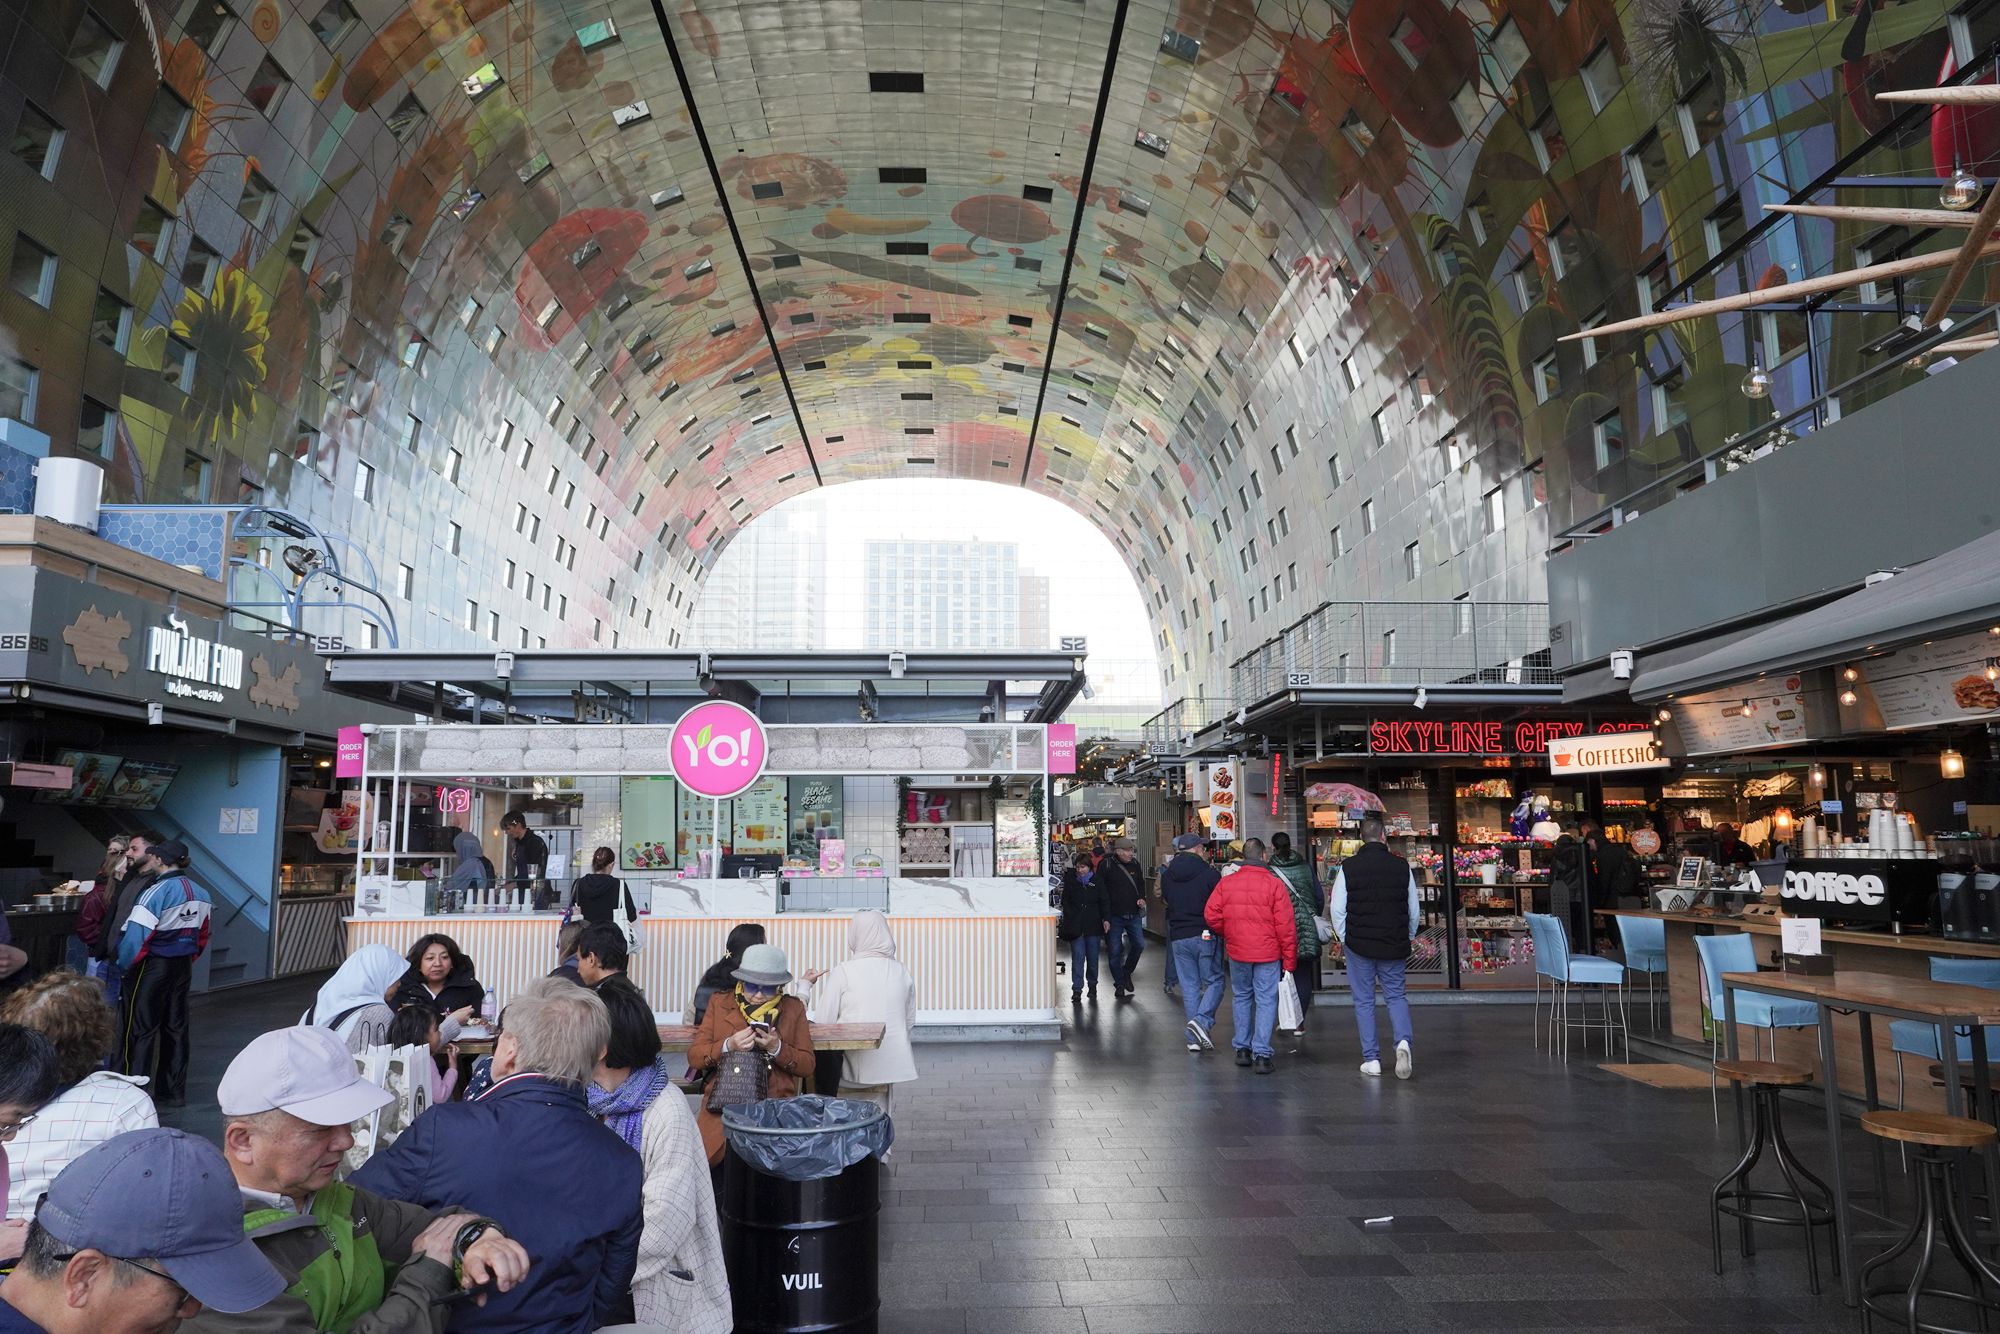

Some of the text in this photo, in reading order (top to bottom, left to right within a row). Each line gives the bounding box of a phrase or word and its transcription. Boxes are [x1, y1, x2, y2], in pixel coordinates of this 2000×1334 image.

[1, 635, 27, 650] 86
[30, 637, 48, 653] 86
[317, 637, 343, 651] 56
[1062, 637, 1086, 651] 52
[149, 614, 243, 690] PUNJABI FOOD
[1290, 674, 1310, 686] 32
[1050, 740, 1074, 748] ORDER
[1370, 722, 1503, 753] SKYLINE
[339, 743, 363, 751] ORDER
[681, 727, 752, 767] YO!
[1053, 750, 1071, 758] HERE
[1153, 745, 1166, 753] 28
[341, 752, 360, 760] HERE
[1577, 746, 1662, 767] COFFEESHO
[804, 785, 830, 797] BLACK
[800, 795, 832, 806] SESAME
[1780, 869, 1885, 906] coffee
[781, 1272, 823, 1291] VUIL
